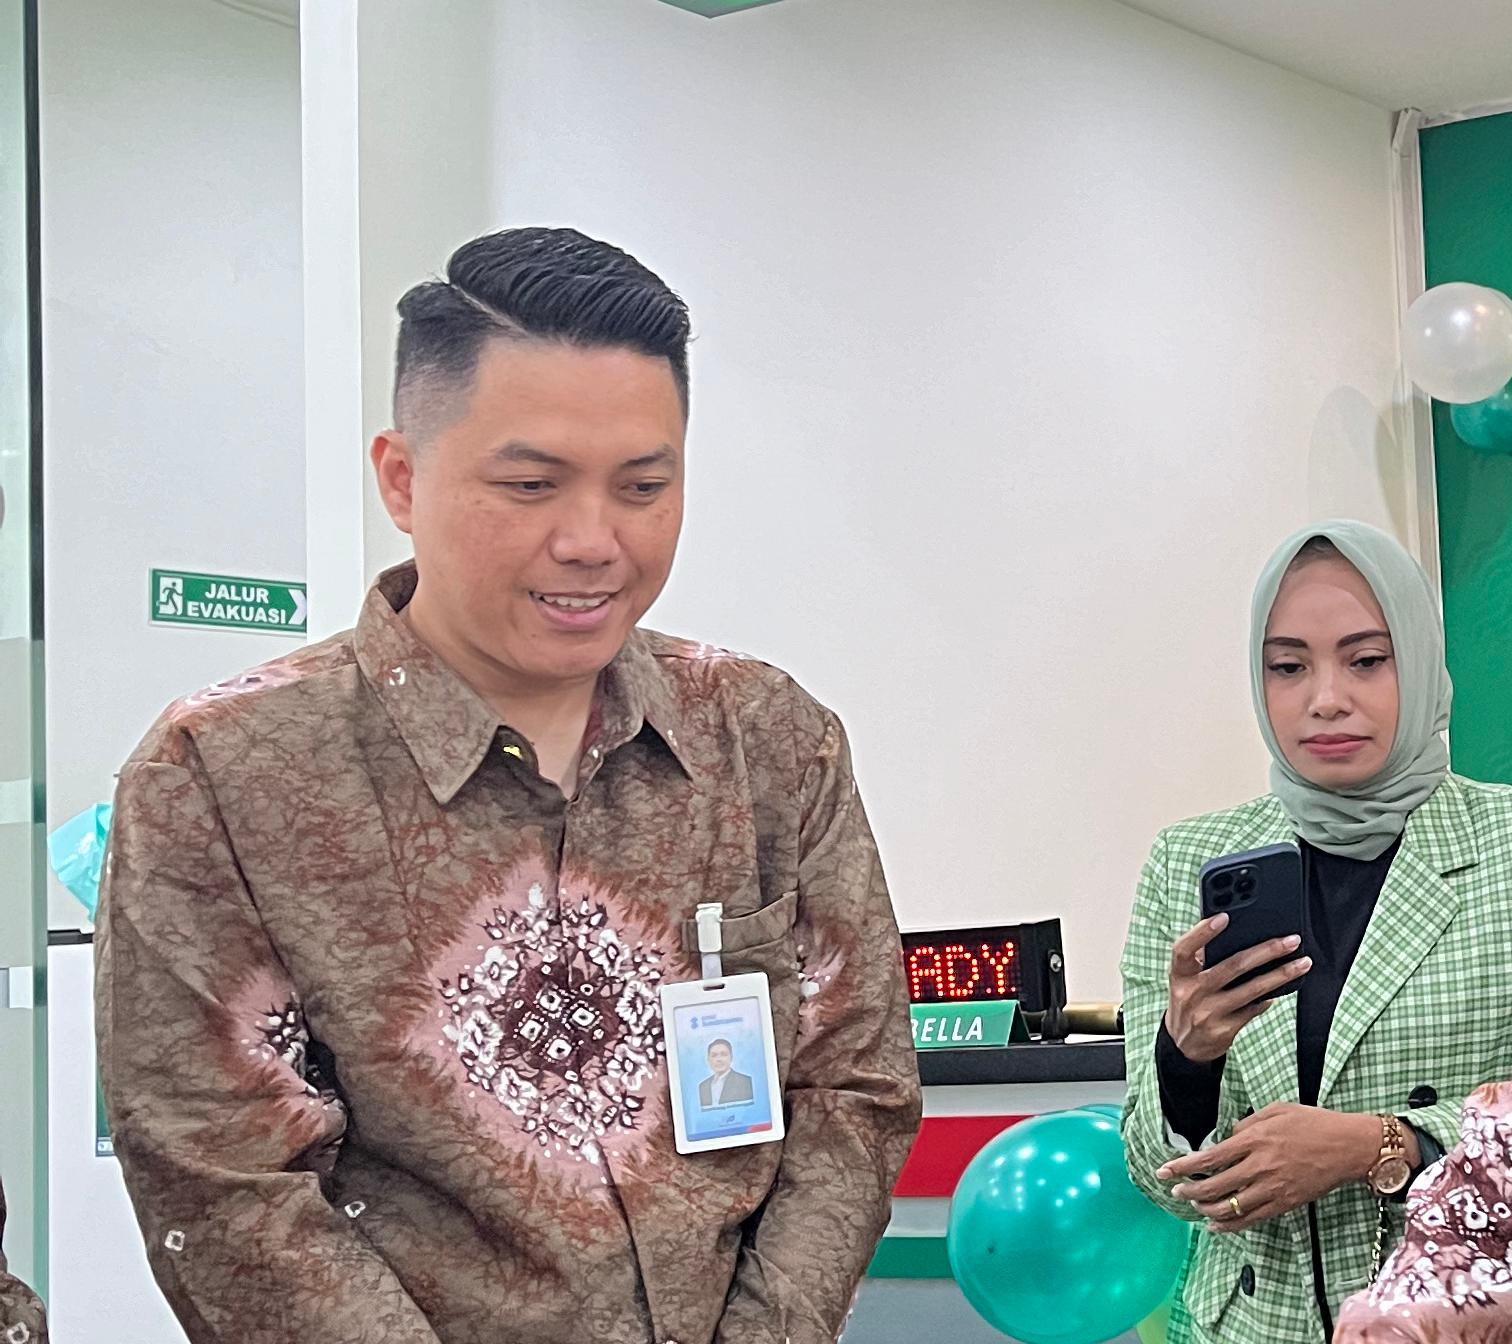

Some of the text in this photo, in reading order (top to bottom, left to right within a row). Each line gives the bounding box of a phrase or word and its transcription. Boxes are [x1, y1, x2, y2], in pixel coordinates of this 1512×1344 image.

[204, 583, 270, 604] JALUR
[186, 601, 287, 625] EVAKUASI
[908, 941, 1015, 999] ADY
